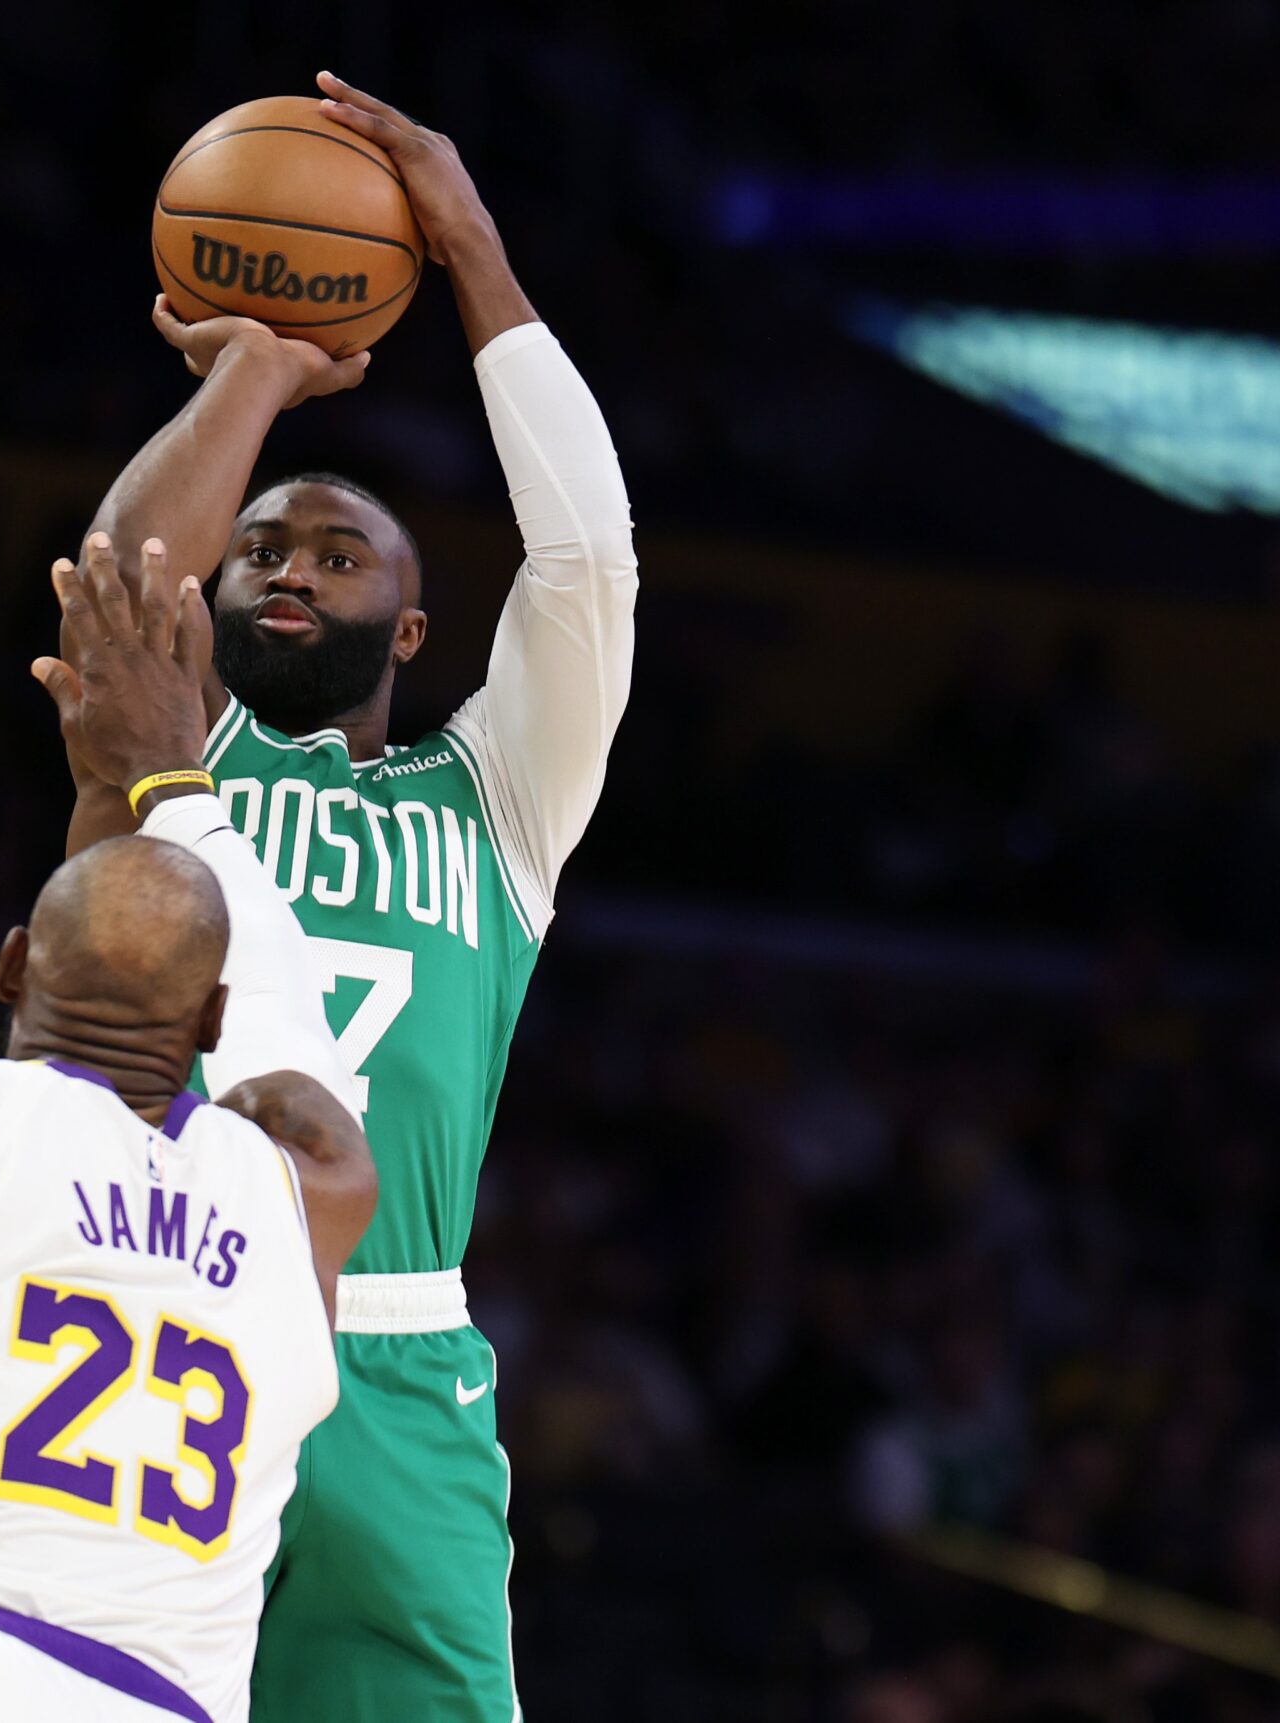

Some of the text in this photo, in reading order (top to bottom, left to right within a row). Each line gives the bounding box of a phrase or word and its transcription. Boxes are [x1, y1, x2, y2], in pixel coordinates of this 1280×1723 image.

[192, 231, 368, 304] Wilson
[372, 750, 454, 781] Amica
[307, 934, 414, 1113] 7
